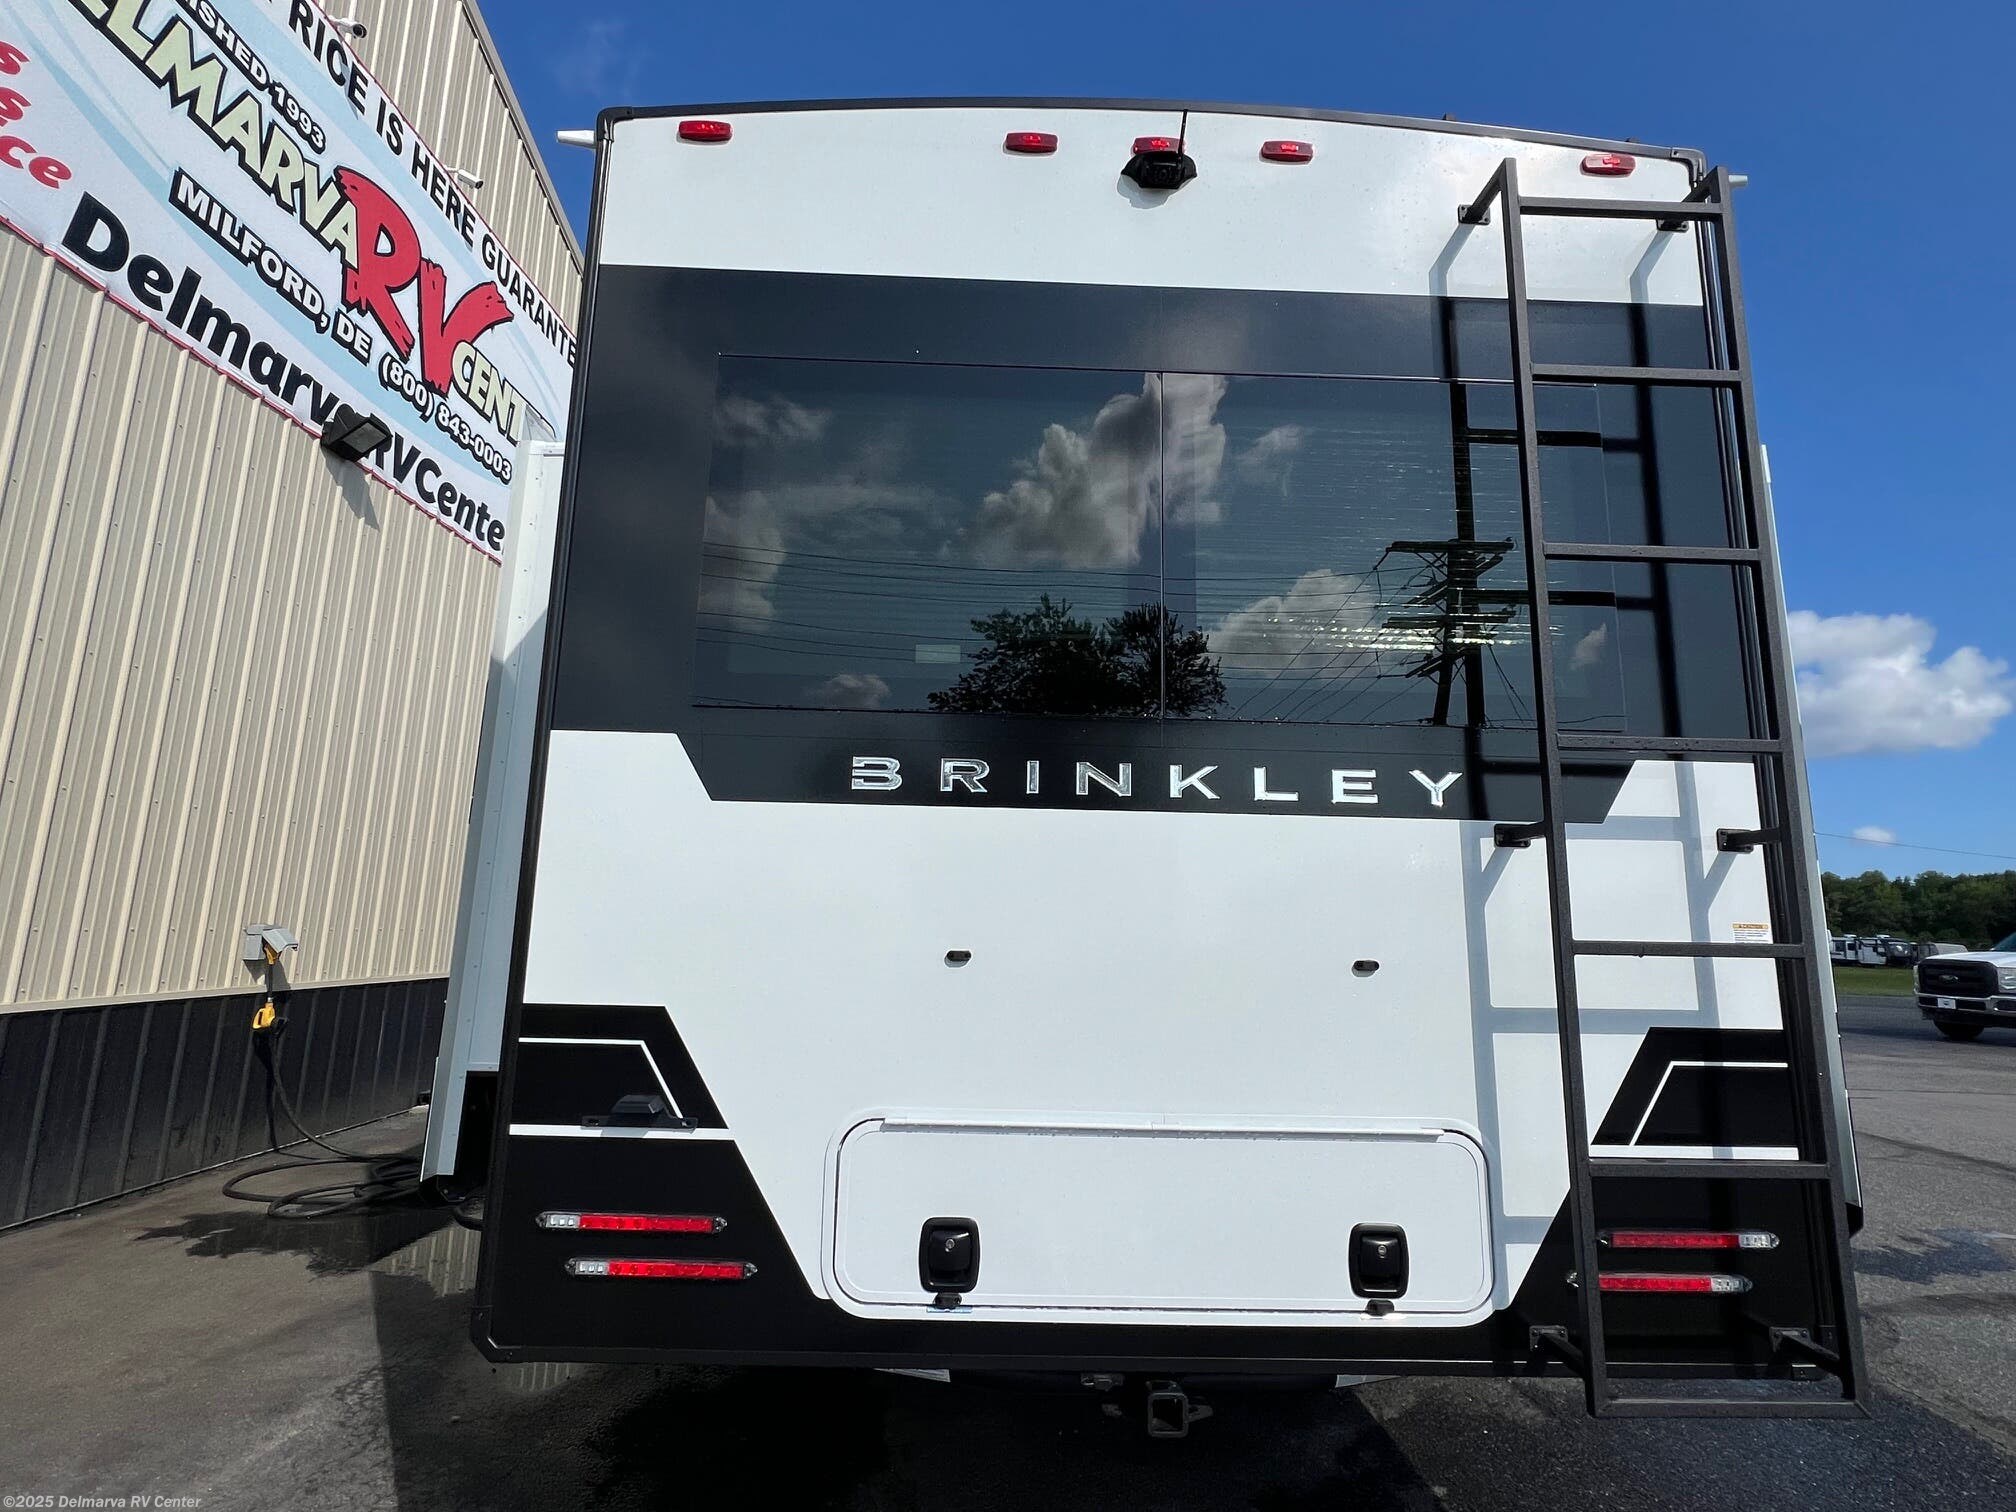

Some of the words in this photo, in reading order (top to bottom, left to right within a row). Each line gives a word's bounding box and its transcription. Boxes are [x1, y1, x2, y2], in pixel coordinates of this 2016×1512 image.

[80, 0, 359, 270] LMARVA
[334, 165, 515, 397] RV
[451, 340, 556, 447] CENT
[268, 0, 369, 115] RICE
[376, 97, 404, 155] IS
[411, 141, 476, 248] HERE
[61, 191, 505, 552] DelmarvVCente
[175, 172, 329, 329] MILFORD,
[336, 318, 372, 361] DE
[381, 353, 434, 417] (800)
[437, 402, 512, 481] 843-0003
[851, 755, 1463, 808] BRINKLEY
